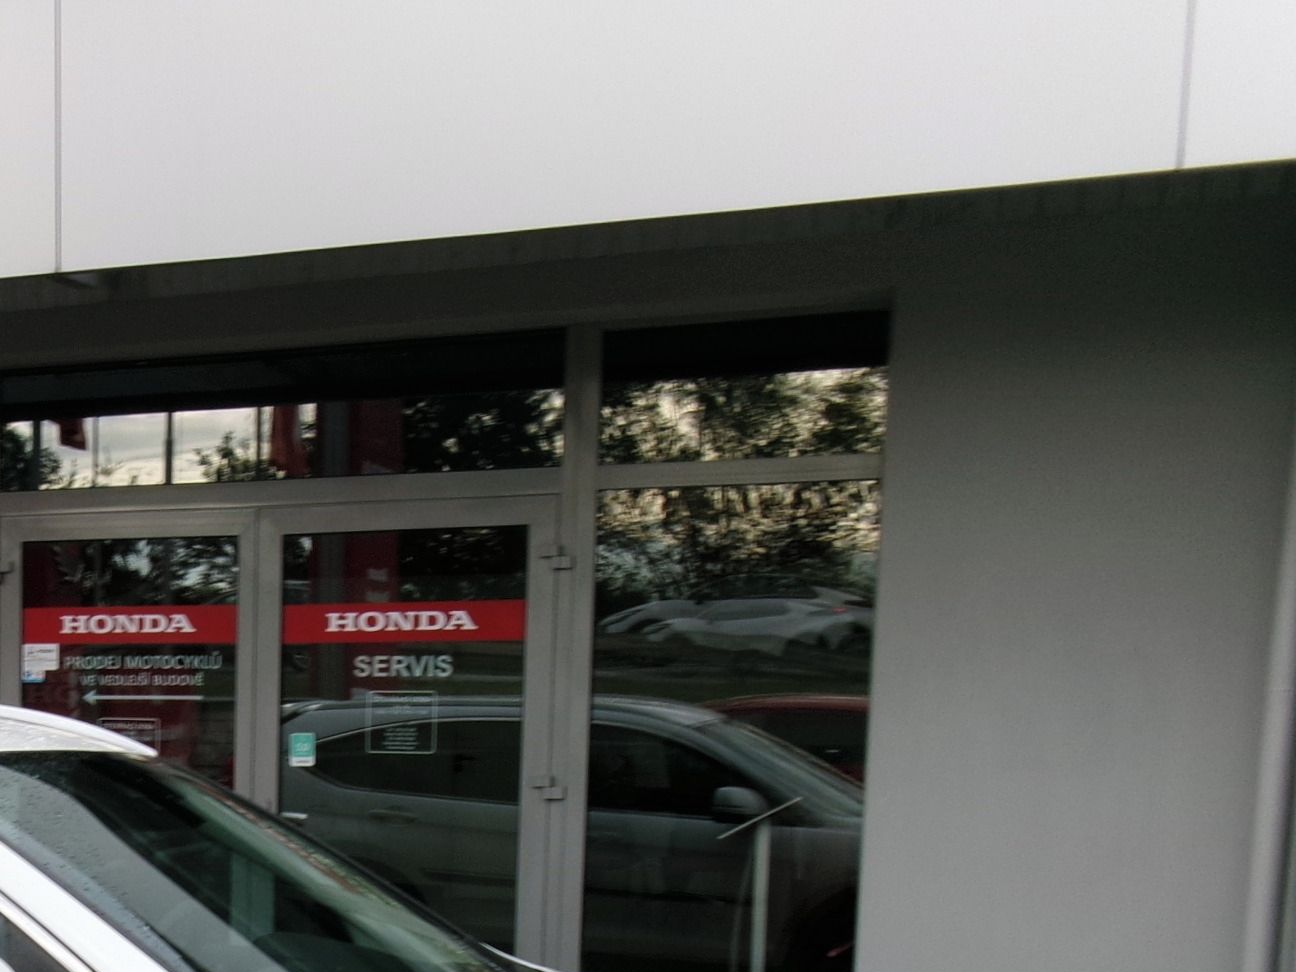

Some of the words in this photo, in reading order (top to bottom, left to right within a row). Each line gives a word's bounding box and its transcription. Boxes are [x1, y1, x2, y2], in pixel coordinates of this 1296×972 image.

[58, 613, 198, 635] HONDA
[324, 610, 480, 633] HONDA
[352, 654, 455, 678] SERVIS
